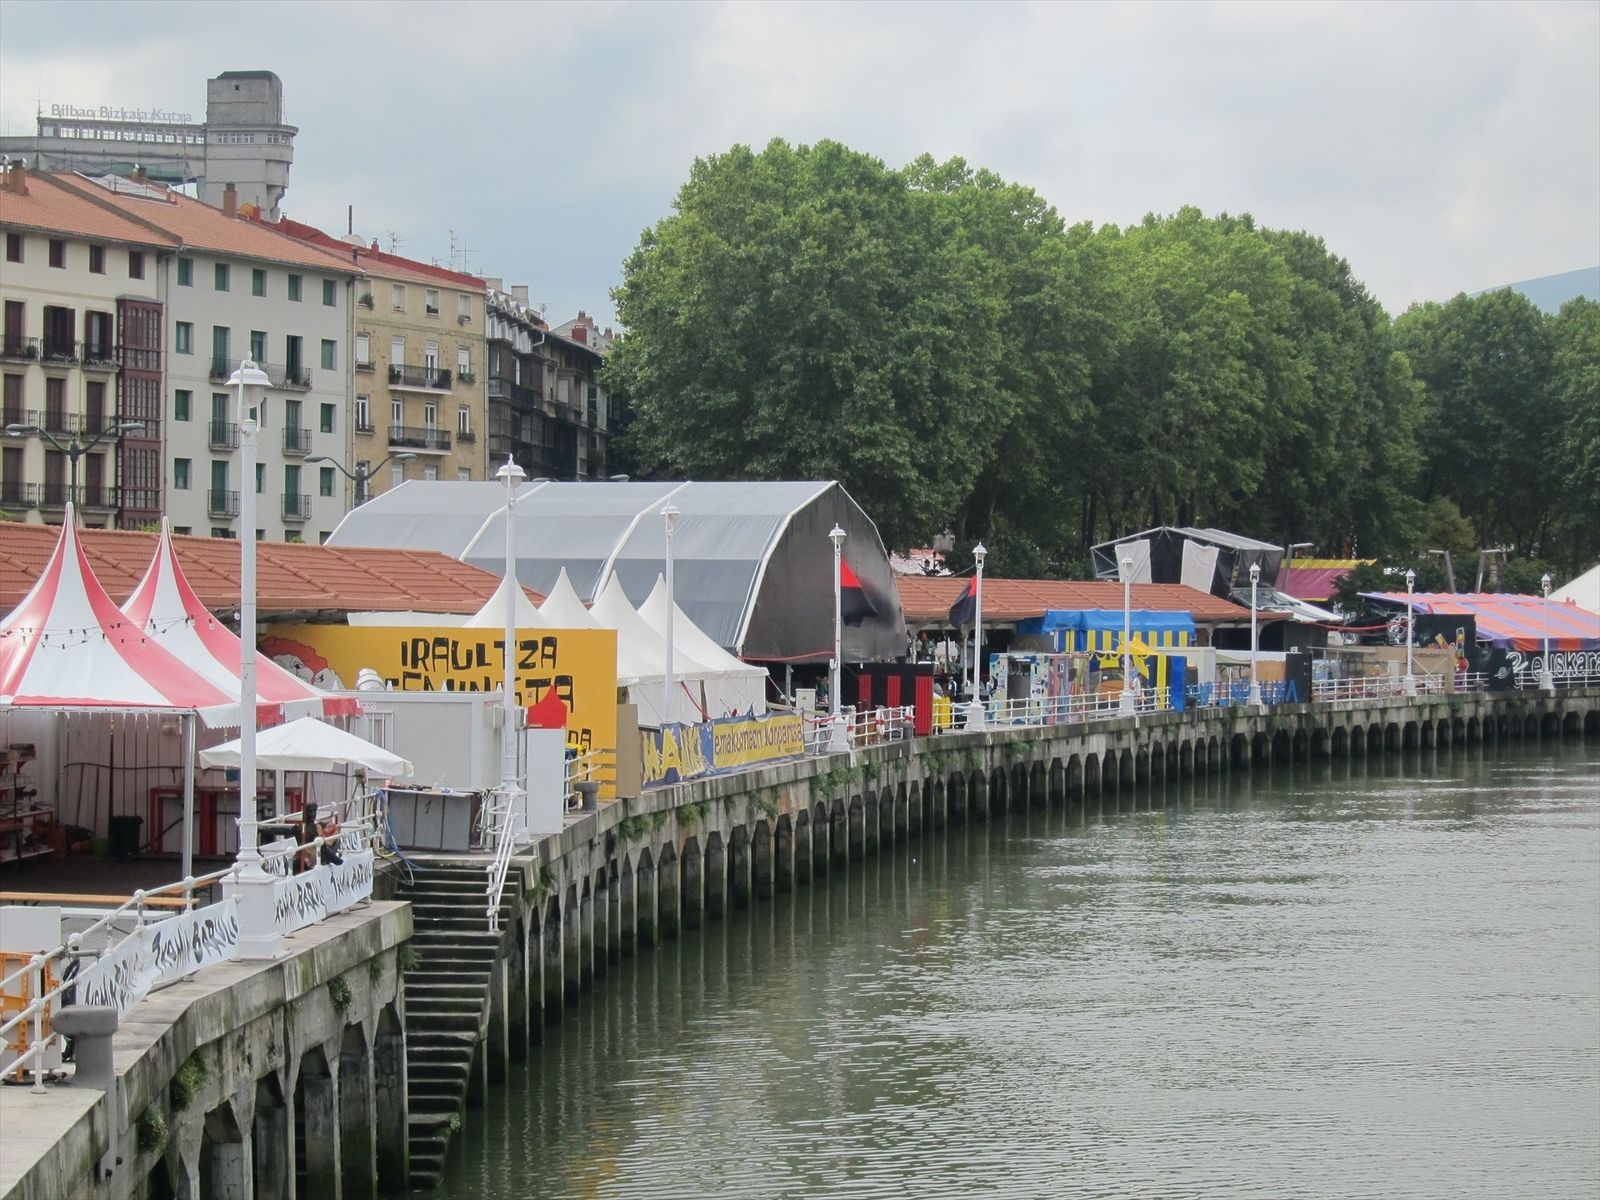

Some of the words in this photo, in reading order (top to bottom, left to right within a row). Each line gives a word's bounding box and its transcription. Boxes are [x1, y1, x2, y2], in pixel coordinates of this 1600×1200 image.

[52, 104, 95, 117] Bilbao
[100, 106, 147, 120] Bizkaia
[152, 108, 192, 122] Kutxa
[401, 636, 557, 674] IRAULTZA
